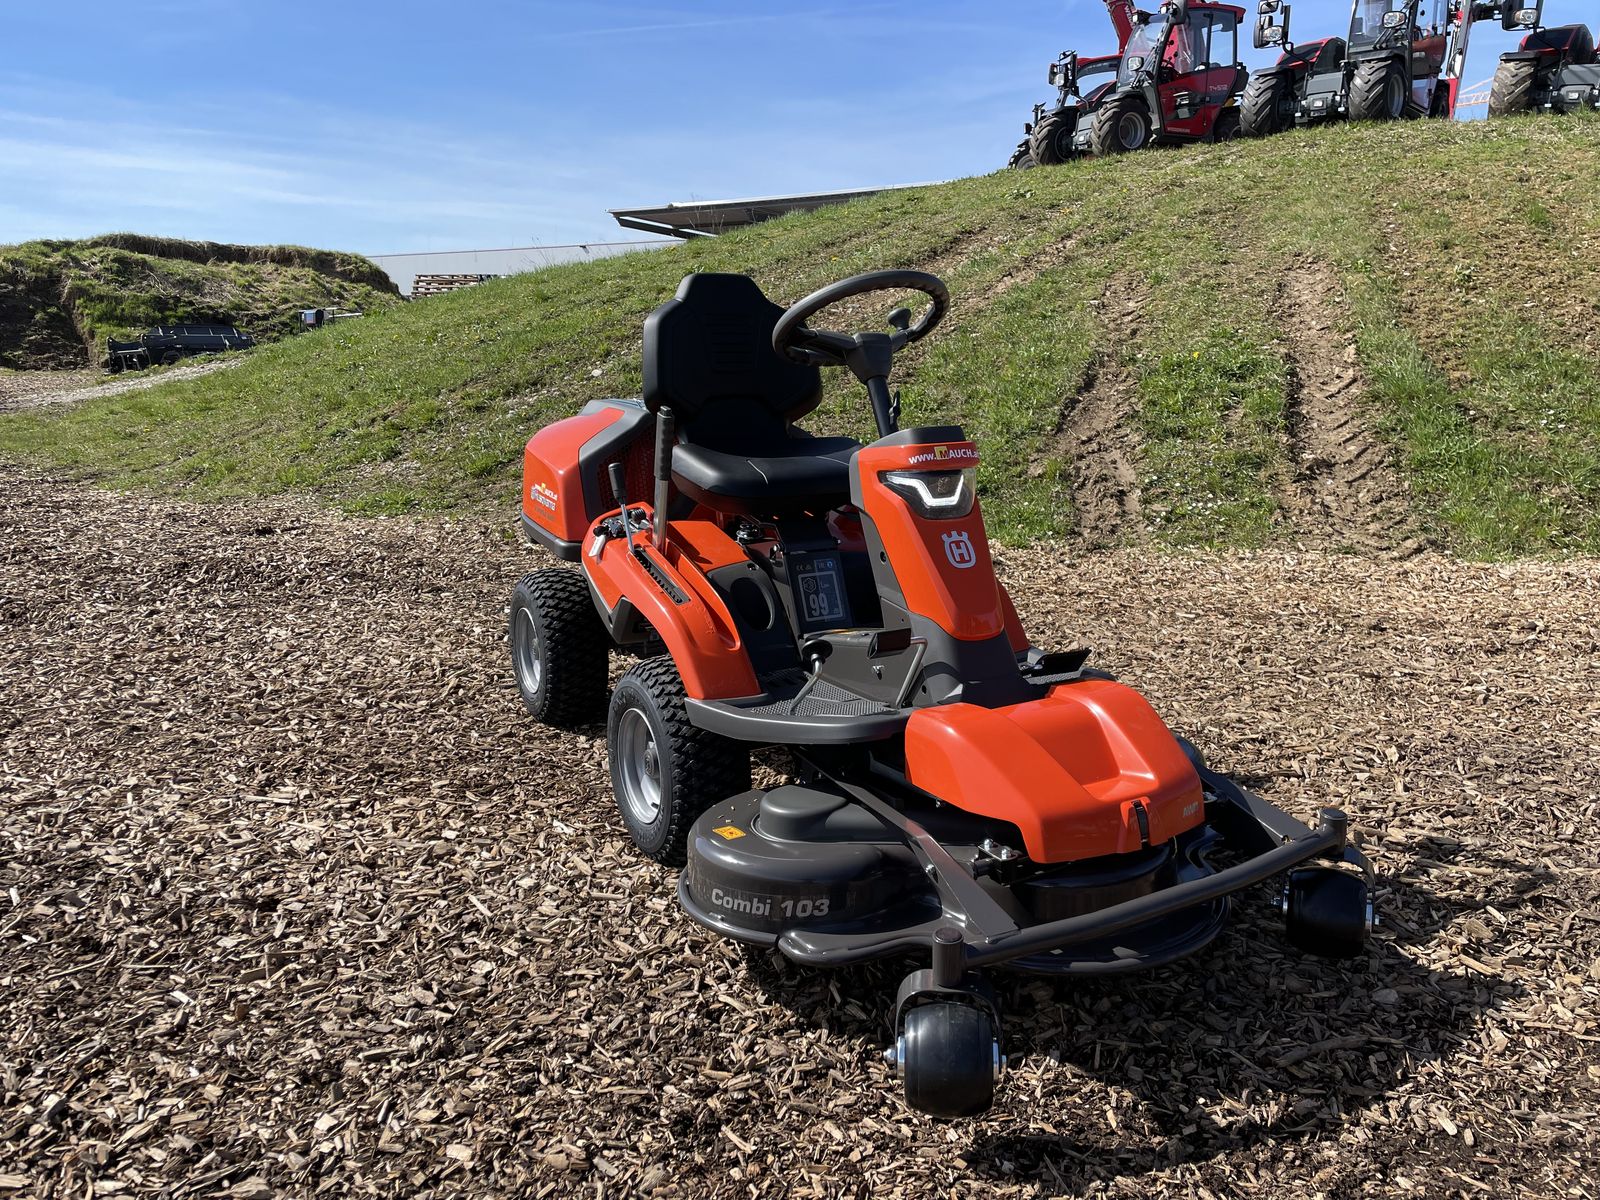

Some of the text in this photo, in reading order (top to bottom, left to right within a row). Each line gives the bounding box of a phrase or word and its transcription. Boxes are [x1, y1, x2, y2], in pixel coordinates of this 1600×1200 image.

[809, 592, 829, 616] 99
[711, 888, 830, 918] Combi 103
